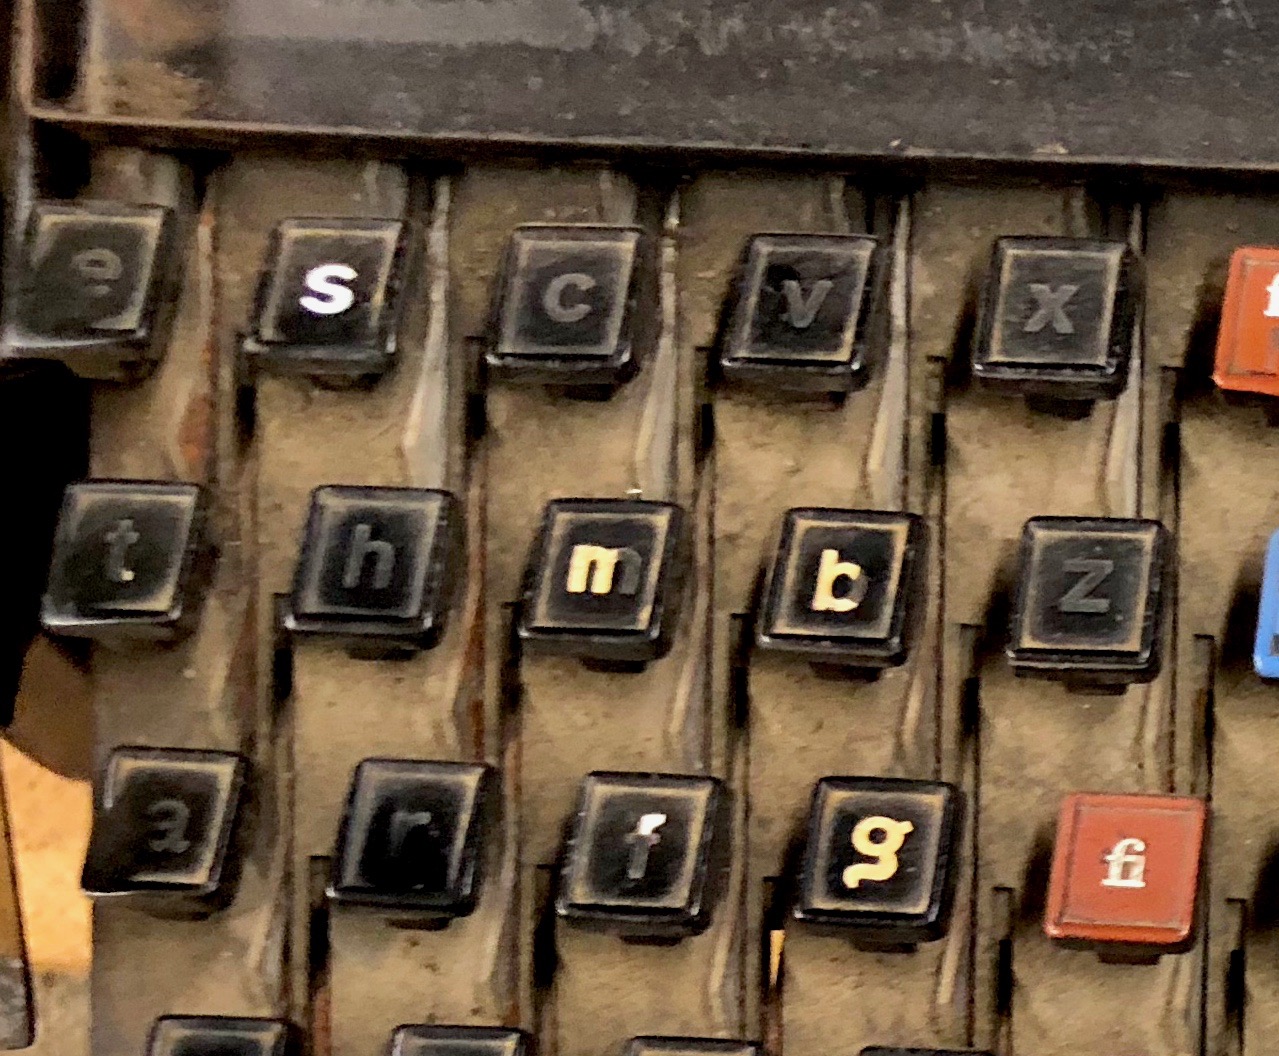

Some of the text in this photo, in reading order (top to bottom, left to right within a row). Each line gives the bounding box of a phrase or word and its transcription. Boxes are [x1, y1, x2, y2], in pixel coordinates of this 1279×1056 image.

[105, 518, 140, 582] t
[343, 522, 396, 590] h
[566, 544, 642, 596] m
[811, 548, 867, 612] b
[625, 813, 668, 879] f
[842, 815, 915, 890] g
